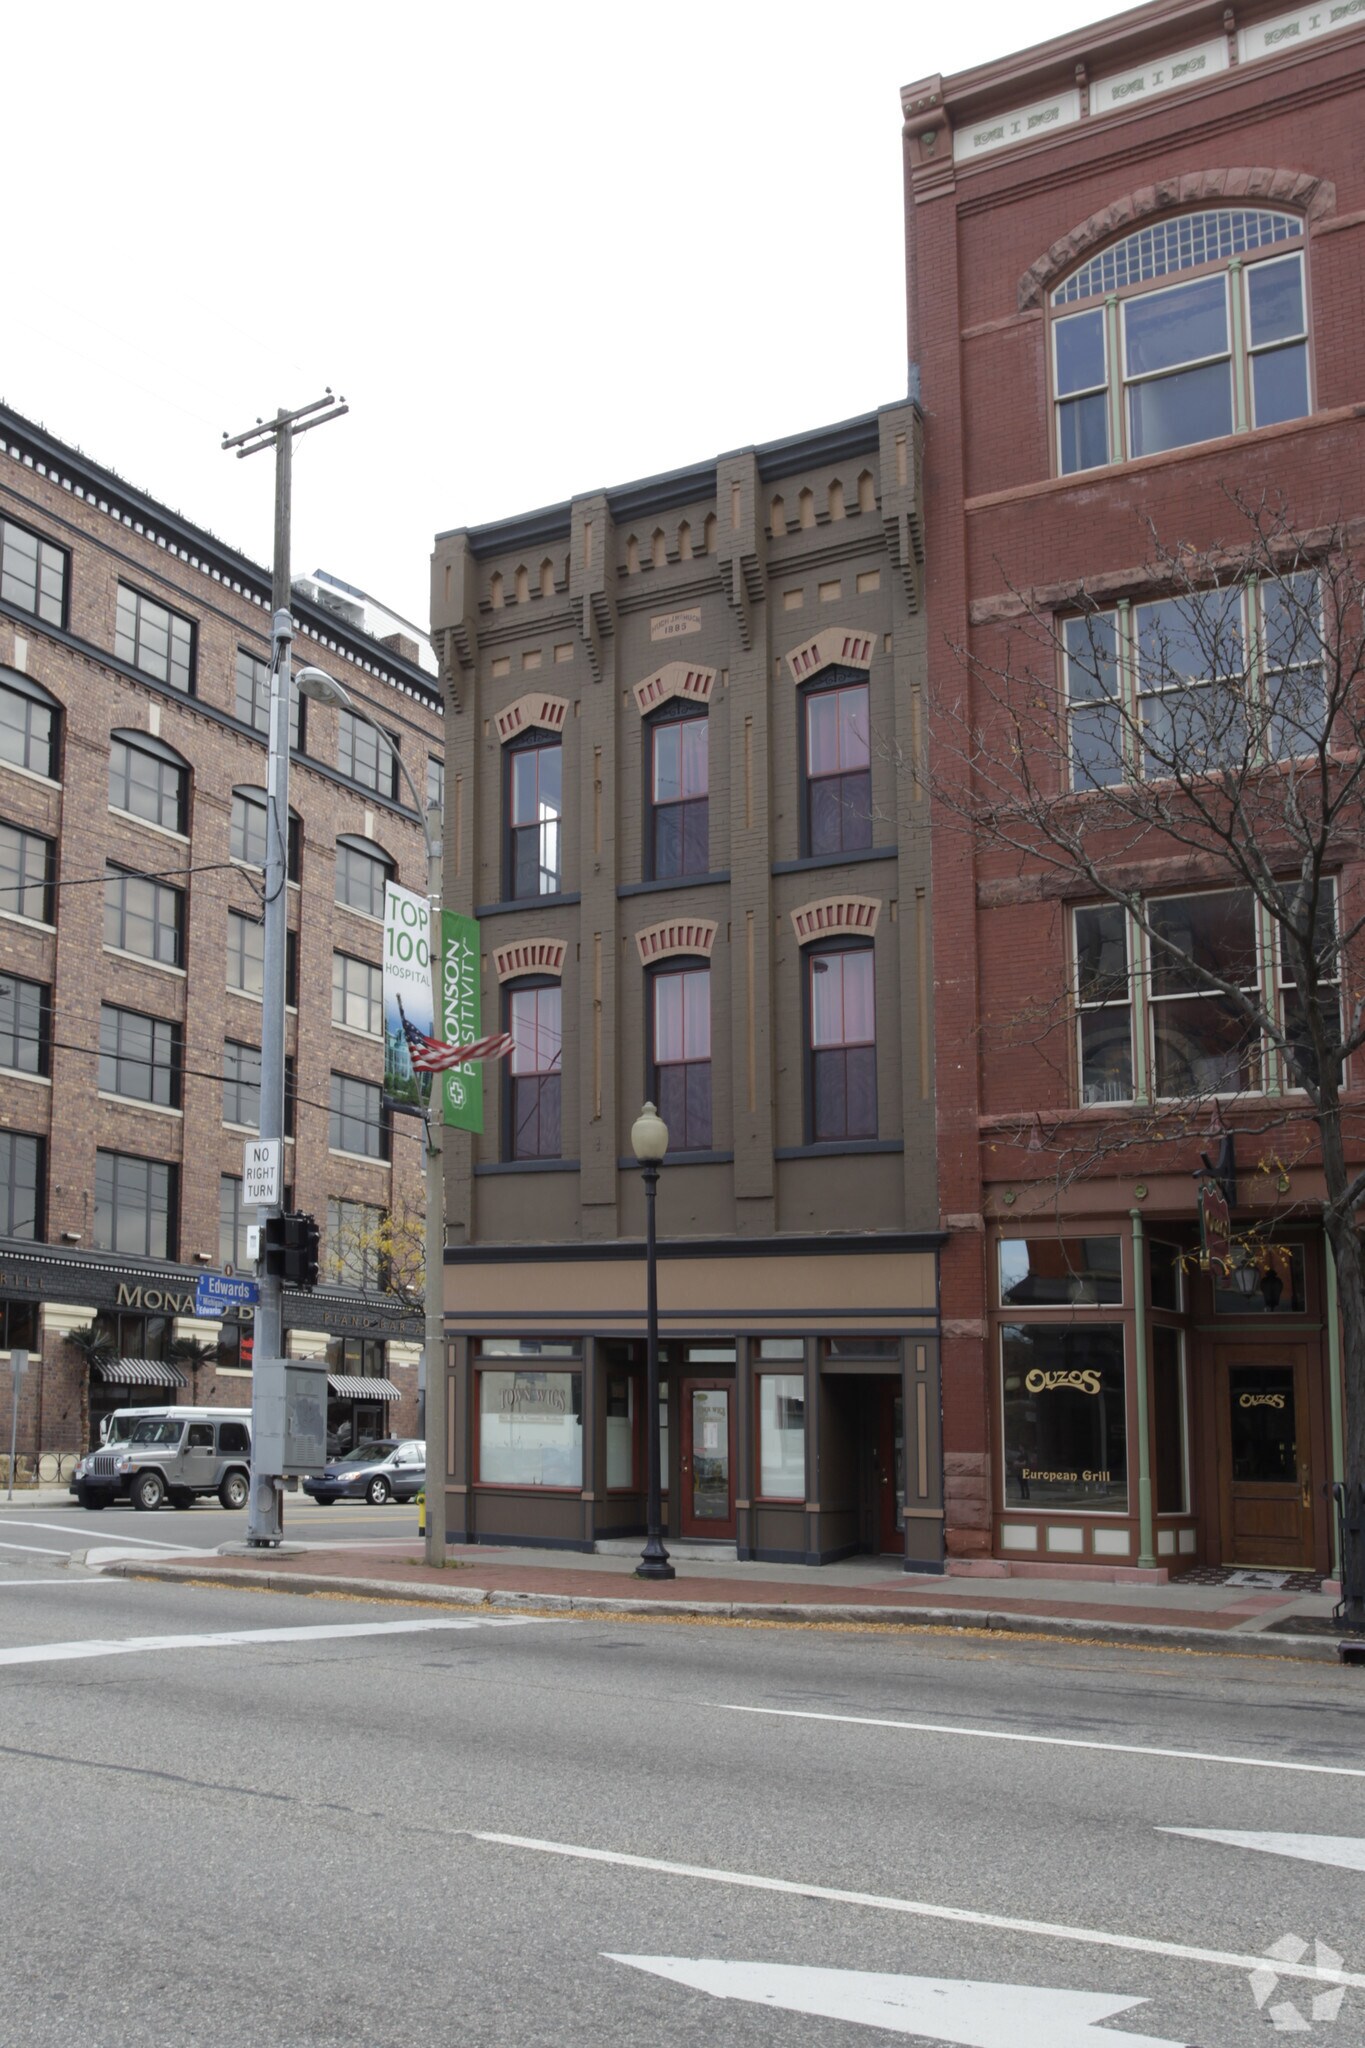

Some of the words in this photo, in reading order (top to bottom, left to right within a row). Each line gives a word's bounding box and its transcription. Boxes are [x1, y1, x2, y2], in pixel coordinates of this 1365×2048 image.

[664, 623, 687, 634] 1885
[388, 892, 428, 931] TOP
[387, 928, 429, 968] 100
[385, 962, 430, 987] HOSPITAL
[444, 938, 461, 1073] ONSON
[461, 942, 476, 1076] PSITIVITY
[253, 1148, 269, 1162] NO
[246, 1166, 275, 1180] RIGHT
[248, 1184, 273, 1197] TURN
[208, 1277, 250, 1298] Edwards
[323, 1311, 370, 1328] PIANO
[379, 1319, 406, 1332] BAR
[1022, 1468, 1078, 1482] European
[1082, 1469, 1110, 1482] Grill
